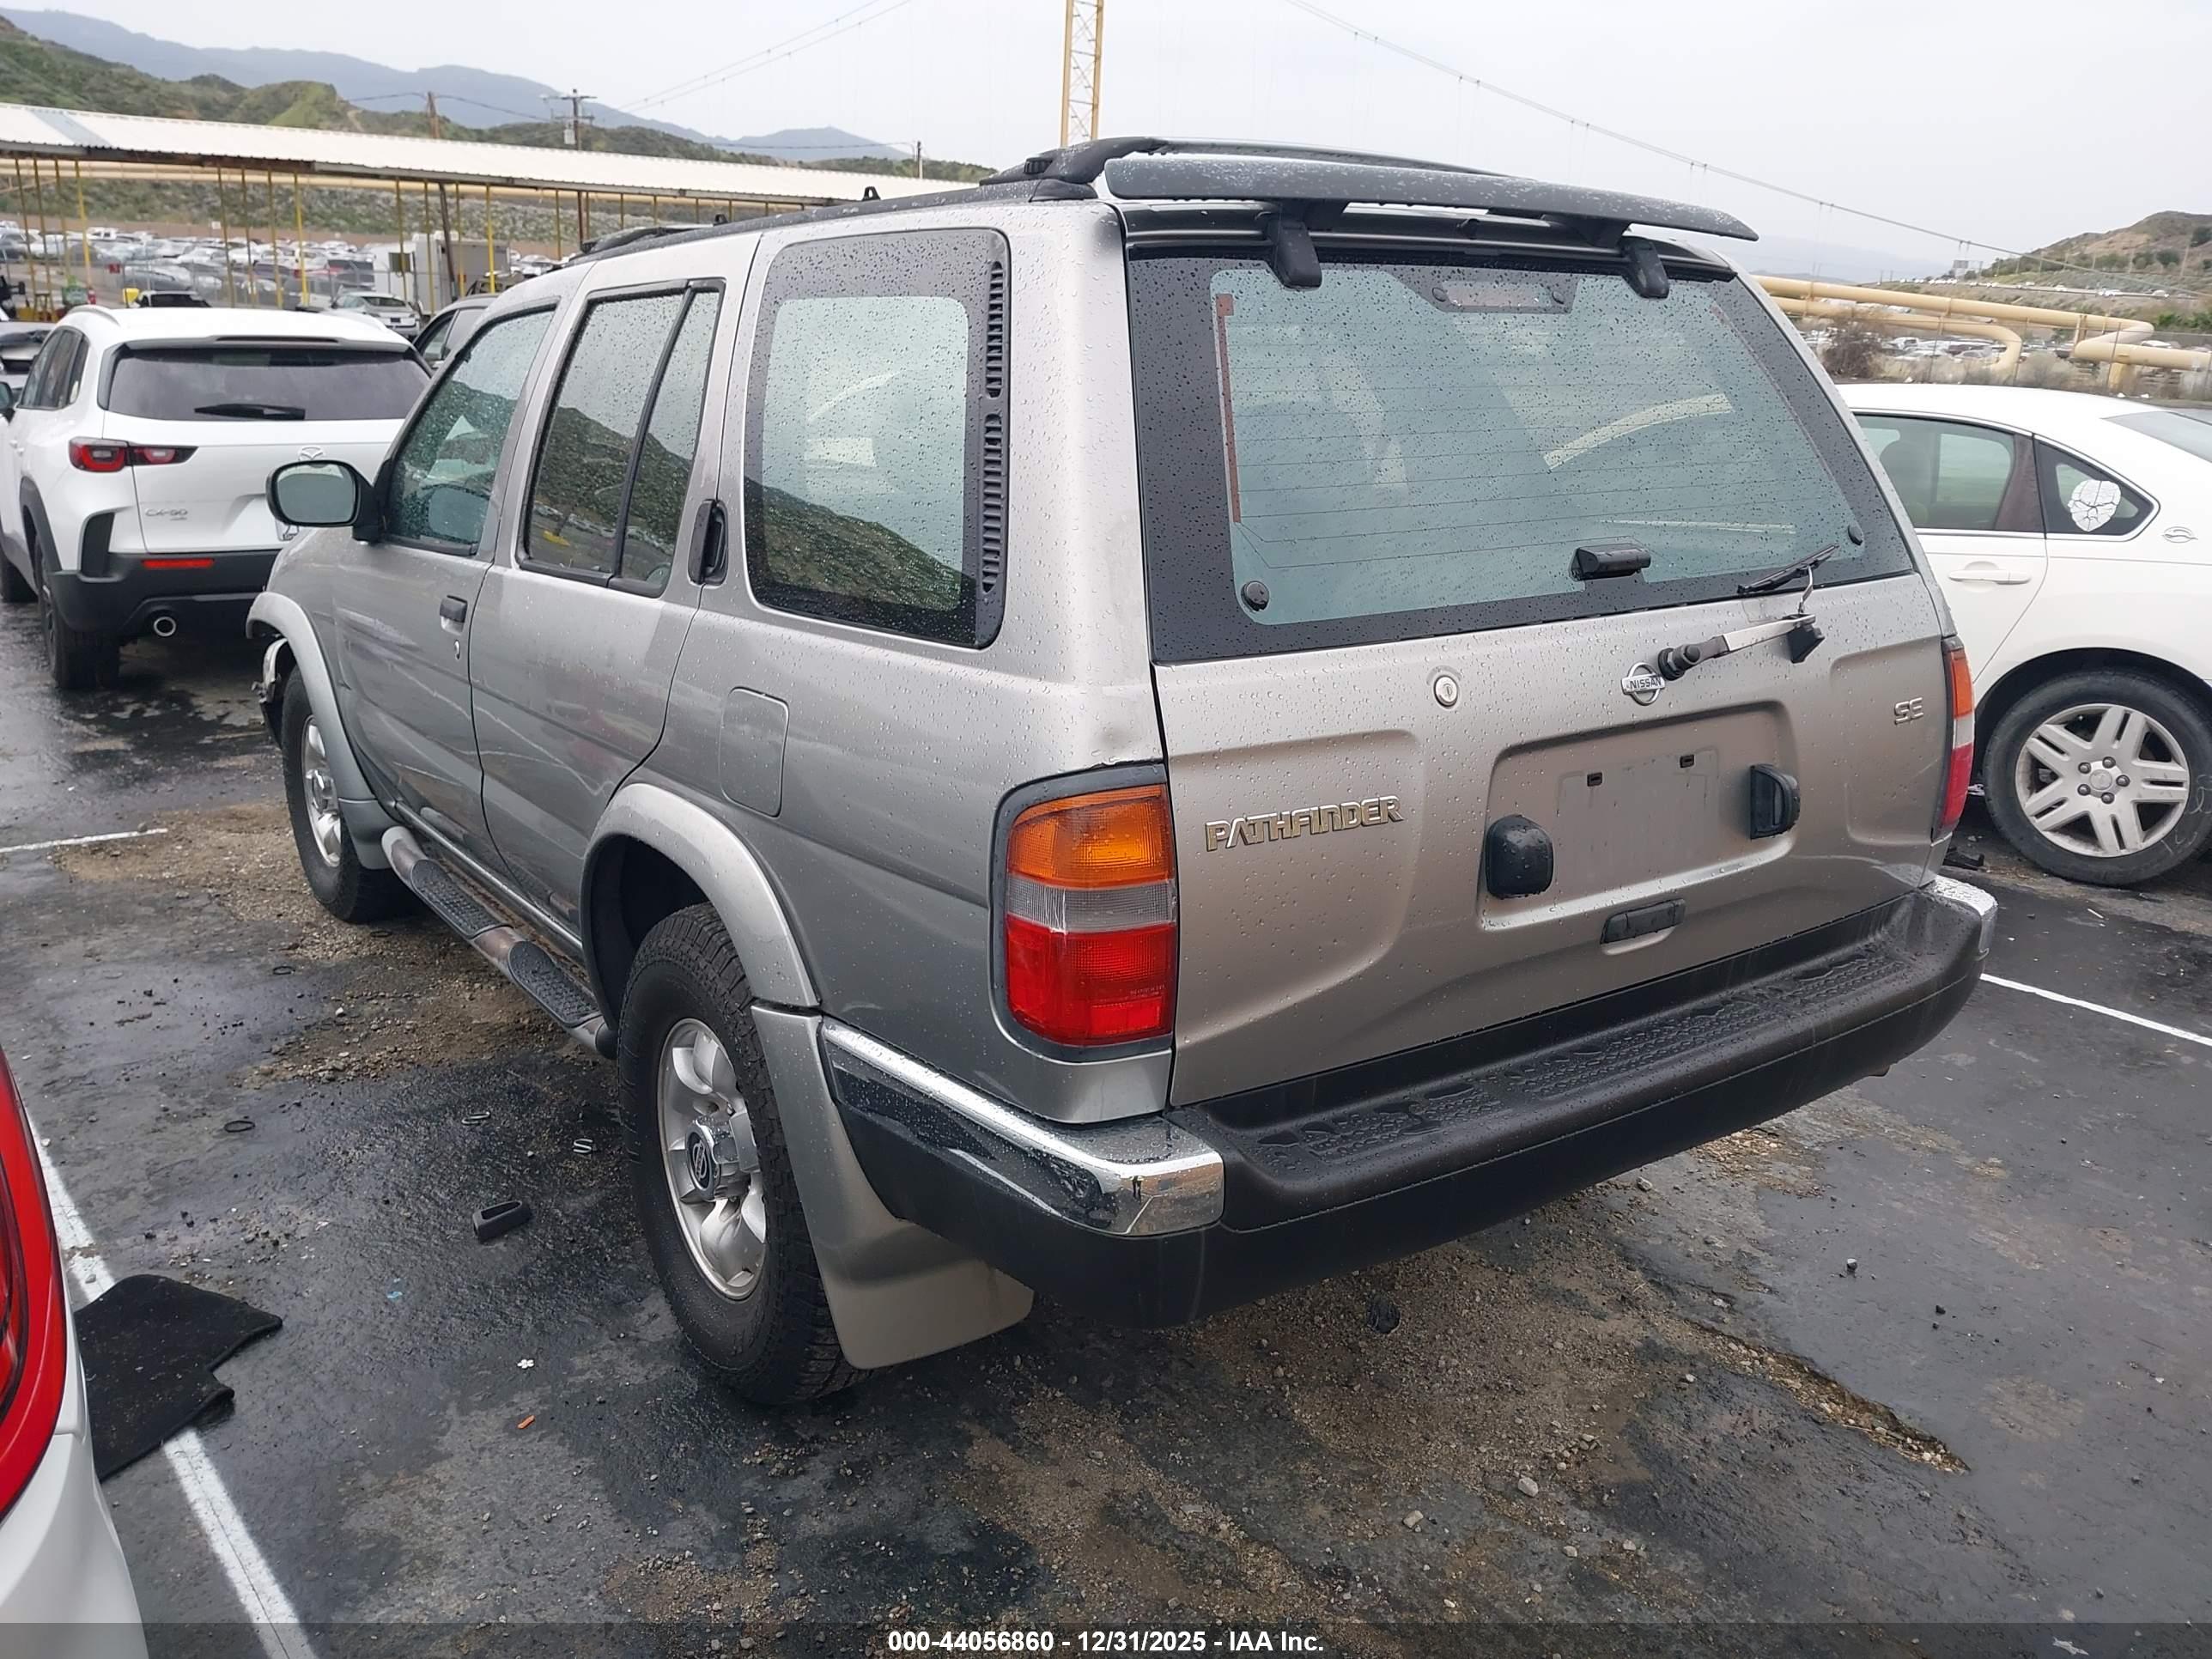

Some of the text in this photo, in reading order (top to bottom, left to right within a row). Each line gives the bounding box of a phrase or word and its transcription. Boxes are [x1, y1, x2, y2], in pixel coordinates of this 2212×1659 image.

[1630, 677, 1662, 690] NISSAN
[1893, 696, 1924, 725] SE
[1205, 795, 1404, 851] PATHFINDER
